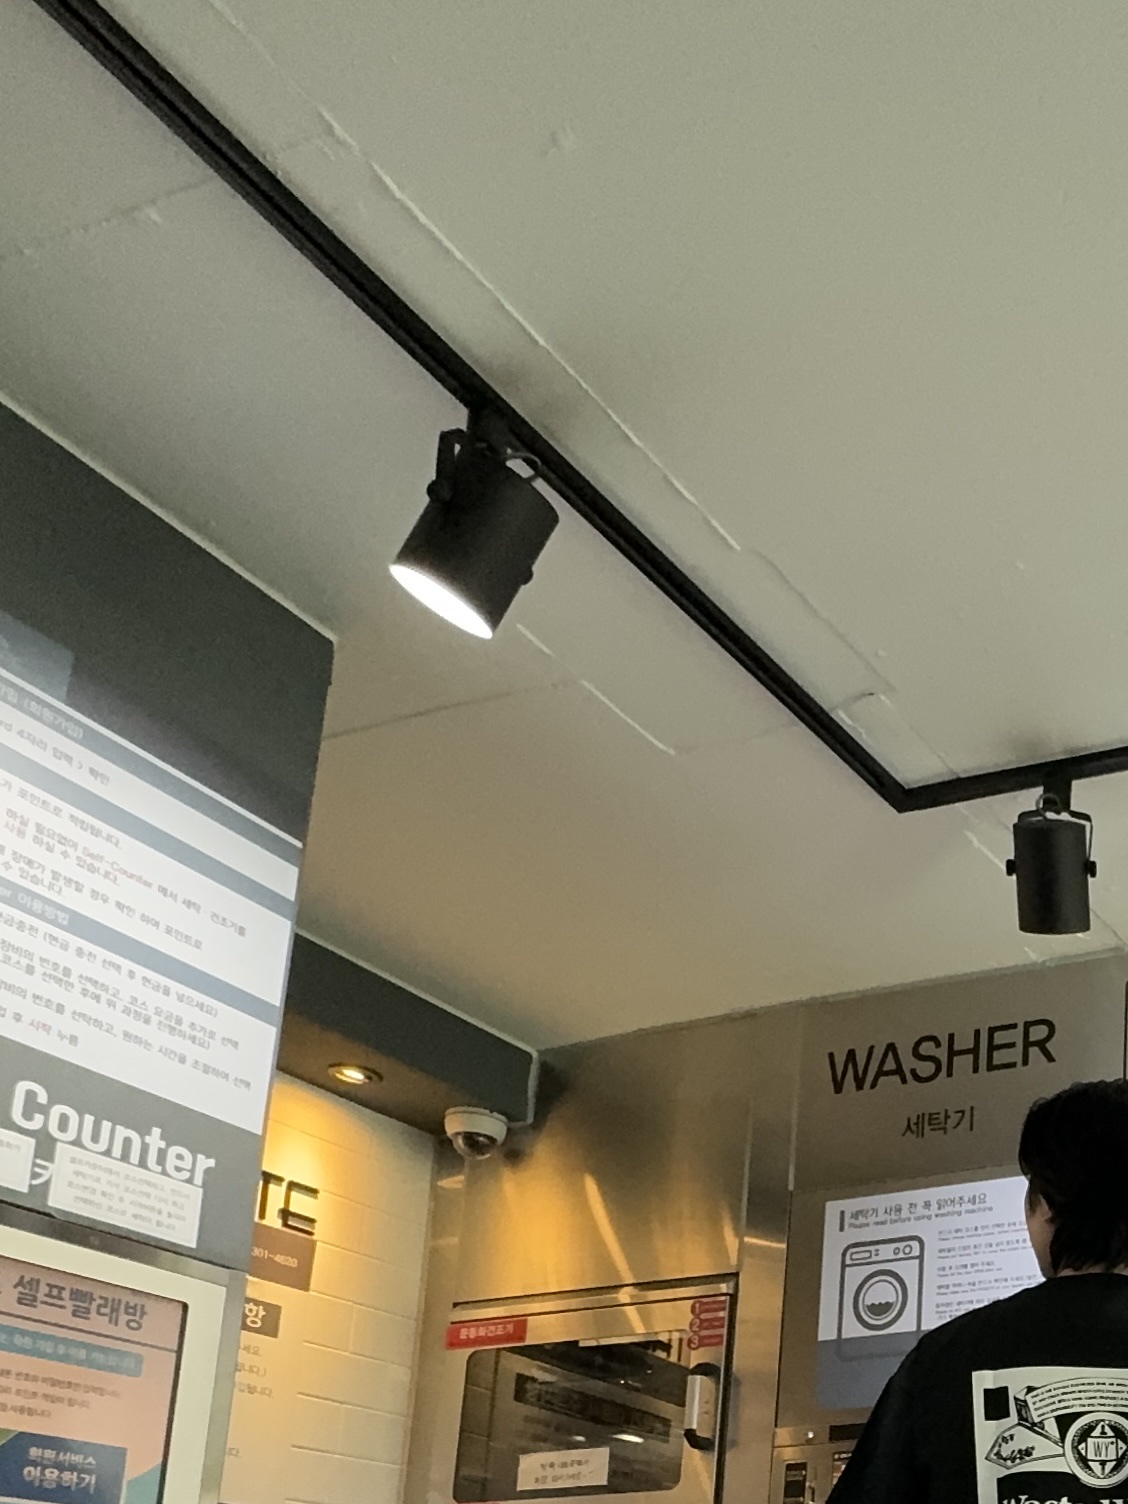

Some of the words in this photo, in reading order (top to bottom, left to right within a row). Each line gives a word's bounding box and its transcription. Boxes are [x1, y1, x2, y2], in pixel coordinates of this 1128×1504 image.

[827, 1017, 1057, 1095] WASHER
[10, 1079, 216, 1188] Counter
[902, 1105, 975, 1139] 세탁기
[13, 1273, 148, 1331] 셀프빨래방
